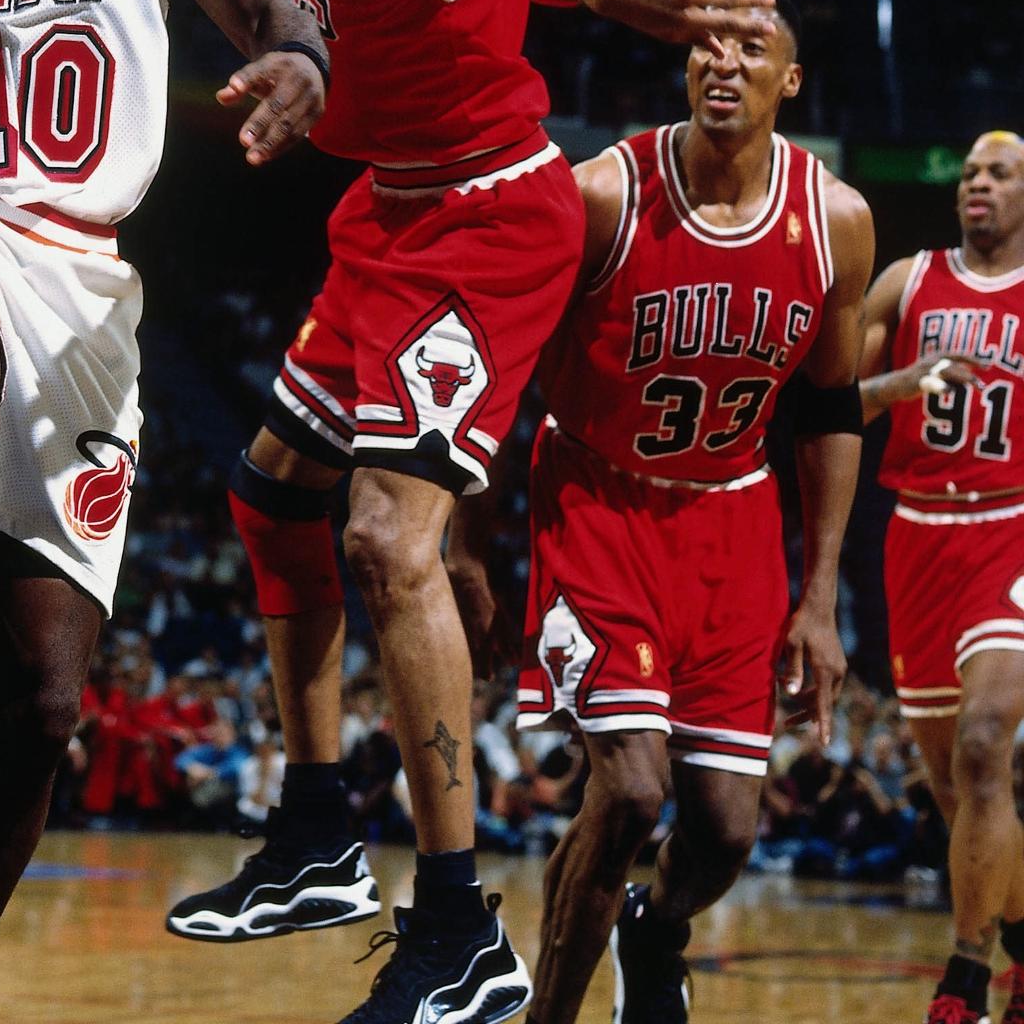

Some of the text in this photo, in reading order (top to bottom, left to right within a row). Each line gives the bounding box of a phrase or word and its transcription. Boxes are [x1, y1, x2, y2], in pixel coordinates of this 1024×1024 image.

[626, 282, 814, 373] BULLS
[919, 308, 1024, 376] BULL
[632, 373, 778, 459] 33
[920, 379, 1014, 463] 91
